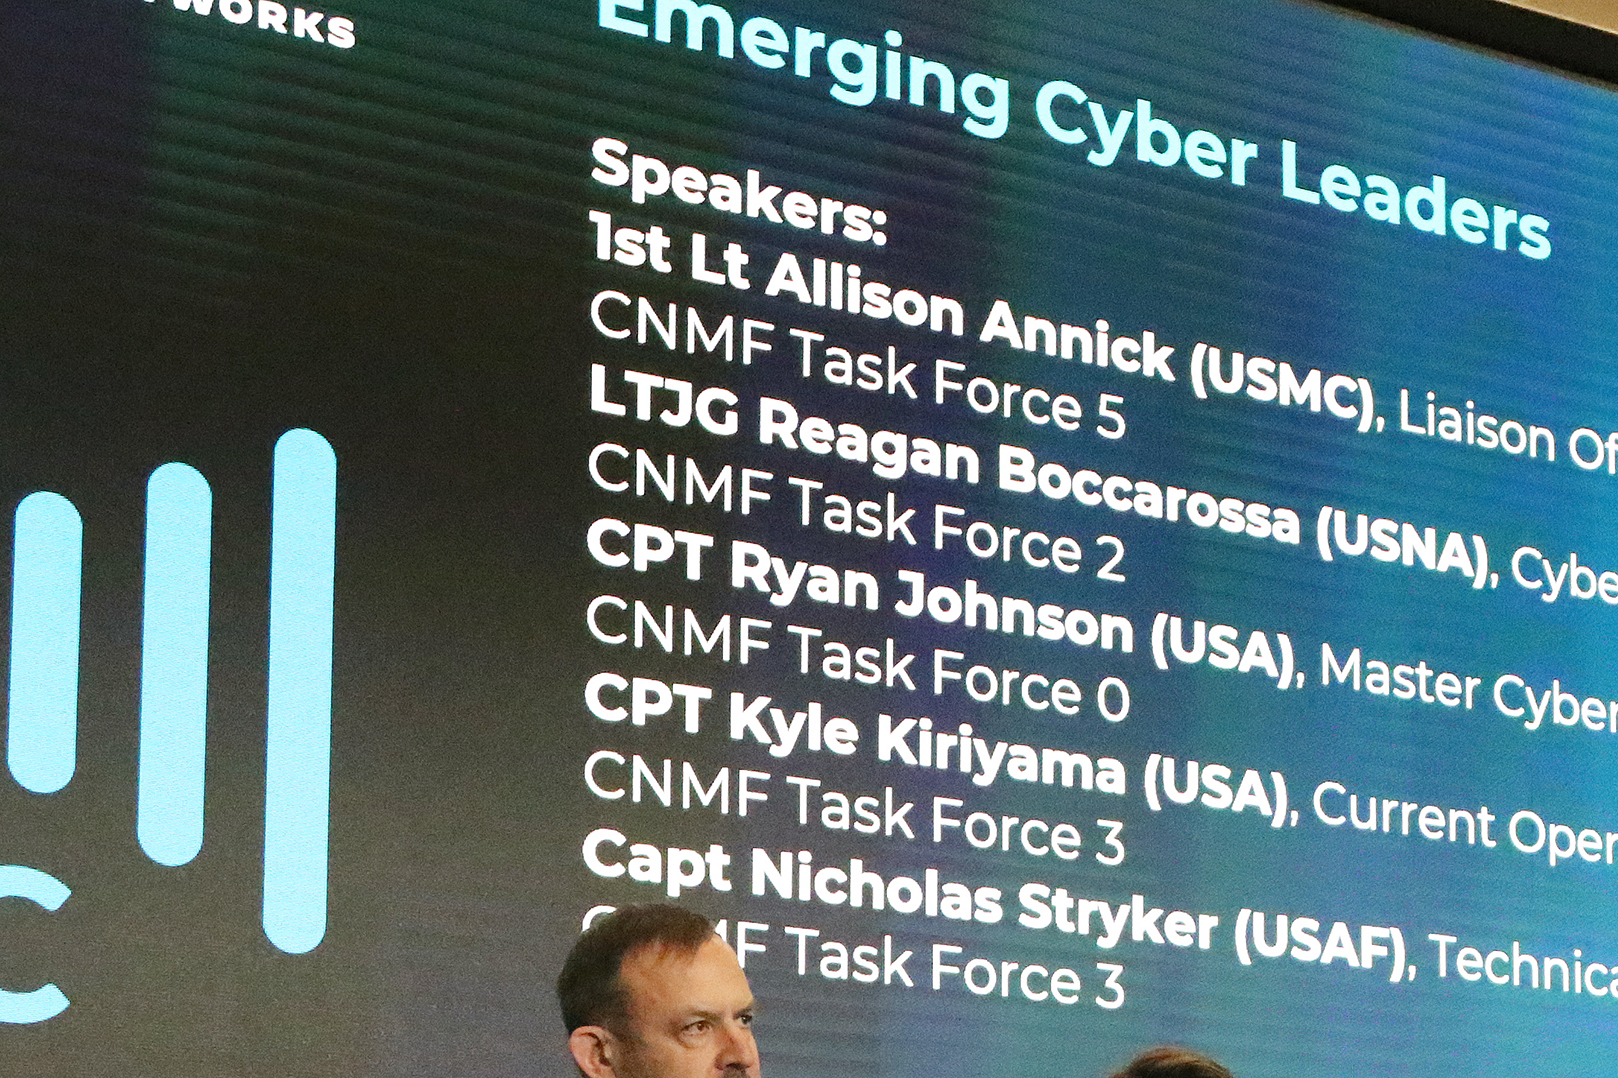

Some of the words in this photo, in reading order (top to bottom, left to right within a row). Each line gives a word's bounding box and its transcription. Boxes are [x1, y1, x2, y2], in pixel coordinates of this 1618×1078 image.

[172, 0, 356, 49] ORKS
[591, 137, 887, 246] Speakers:
[599, 0, 1009, 139] Emerging
[1035, 80, 1258, 186] Cyber
[1282, 139, 1552, 260] Leaders
[588, 210, 672, 273] 1st
[691, 233, 751, 290] Lt
[764, 252, 964, 336] Allison
[979, 300, 1176, 382] Annick
[1190, 342, 1385, 433] (USMC),
[1400, 388, 1555, 462] Liaison
[590, 290, 775, 365] CNMF
[789, 328, 918, 399] Task
[935, 359, 1082, 431] Force
[1096, 393, 1126, 440] 5
[588, 442, 774, 515] CNMF
[788, 476, 917, 546] Task
[934, 504, 1082, 573] Force
[1096, 535, 1126, 582] 2
[591, 363, 739, 436] LTJG
[759, 396, 980, 484] Reagan
[998, 444, 1300, 545] Boccarossa
[1316, 505, 1499, 590] (USNA),
[586, 518, 714, 581] CPT
[731, 540, 879, 611] Ryan
[894, 569, 1134, 653] Johnson
[1151, 612, 1305, 690] (USA),
[1321, 642, 1482, 710] Master
[586, 595, 773, 665] CNMF
[787, 625, 917, 691] Task
[933, 649, 1082, 715] Force
[1097, 676, 1130, 722] 0
[584, 672, 713, 734] CPT
[730, 692, 860, 758] Kyle
[878, 713, 1126, 795] Kiriyama
[1143, 753, 1299, 829] (USA),
[1313, 781, 1497, 848] Current
[584, 750, 771, 817] CNMF
[785, 775, 915, 839] Task
[933, 796, 1082, 860] Force
[1095, 818, 1125, 866] 3
[582, 828, 733, 898] Capt
[751, 847, 1004, 924] Nicholas
[1017, 882, 1219, 950] Stryker
[1234, 908, 1417, 983] (USAF),
[784, 926, 915, 988] Task
[932, 943, 1081, 1005] Force
[1095, 962, 1125, 1010] 3
